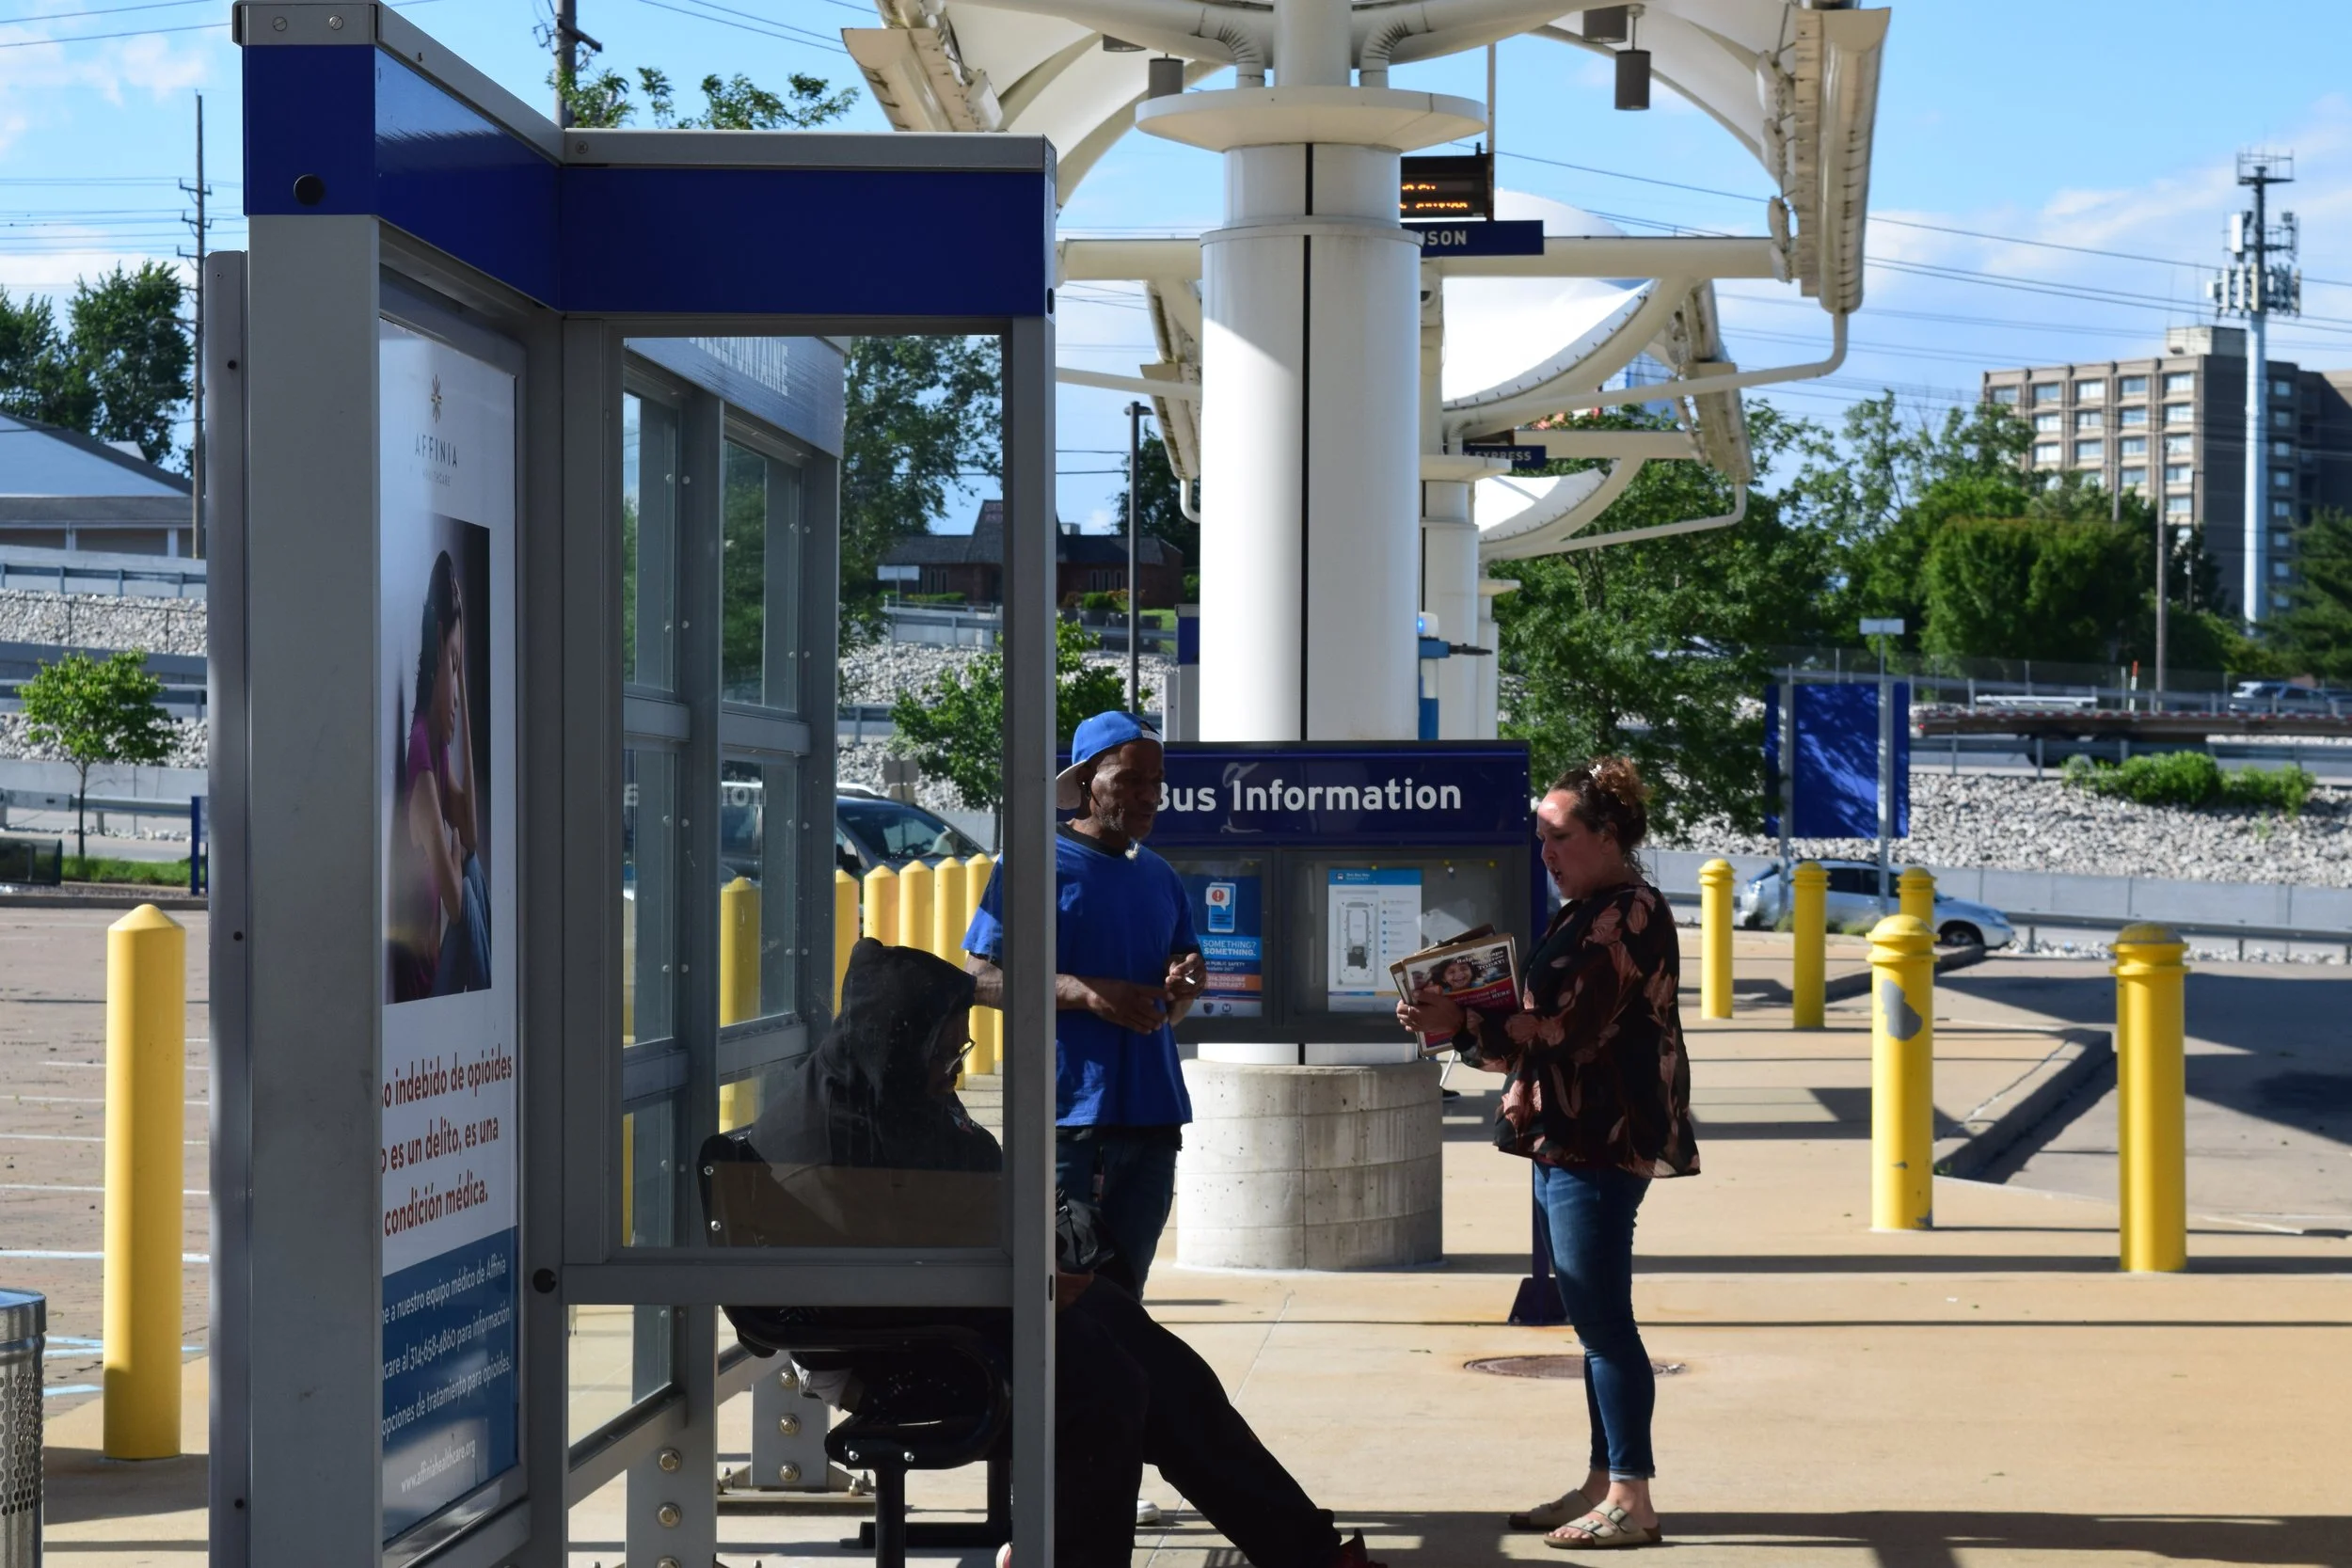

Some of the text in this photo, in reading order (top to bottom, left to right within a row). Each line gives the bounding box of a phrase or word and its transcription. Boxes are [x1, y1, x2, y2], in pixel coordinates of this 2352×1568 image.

[415, 433, 458, 467] AFFINIA
[1156, 778, 1461, 812] Bus Information
[1203, 941, 1256, 949] SOMETHING?
[1204, 948, 1256, 957] SOMETHING.
[395, 1055, 447, 1105] indebido
[451, 1052, 464, 1092] de
[468, 1043, 512, 1097] opioides
[390, 1144, 404, 1171] es
[407, 1137, 421, 1165] un
[426, 1117, 462, 1160] delito,
[465, 1122, 476, 1147] es
[480, 1117, 499, 1145] una
[385, 1169, 487, 1236] condición médica.
[391, 1305, 395, 1322] a
[397, 1290, 424, 1318] nuestro
[426, 1278, 450, 1310] equipo
[451, 1264, 474, 1292] médico
[476, 1259, 485, 1285] de
[486, 1253, 506, 1279] Affinia
[403, 1343, 408, 1370] al
[410, 1329, 455, 1370] 314-658-4860
[457, 1324, 471, 1352] para
[473, 1300, 510, 1338] información
[382, 1404, 415, 1441] opciones
[416, 1391, 425, 1418] de
[426, 1378, 466, 1412] tratamiento
[468, 1370, 482, 1398] para
[401, 1439, 476, 1493] www.affiniahealthcare.org
